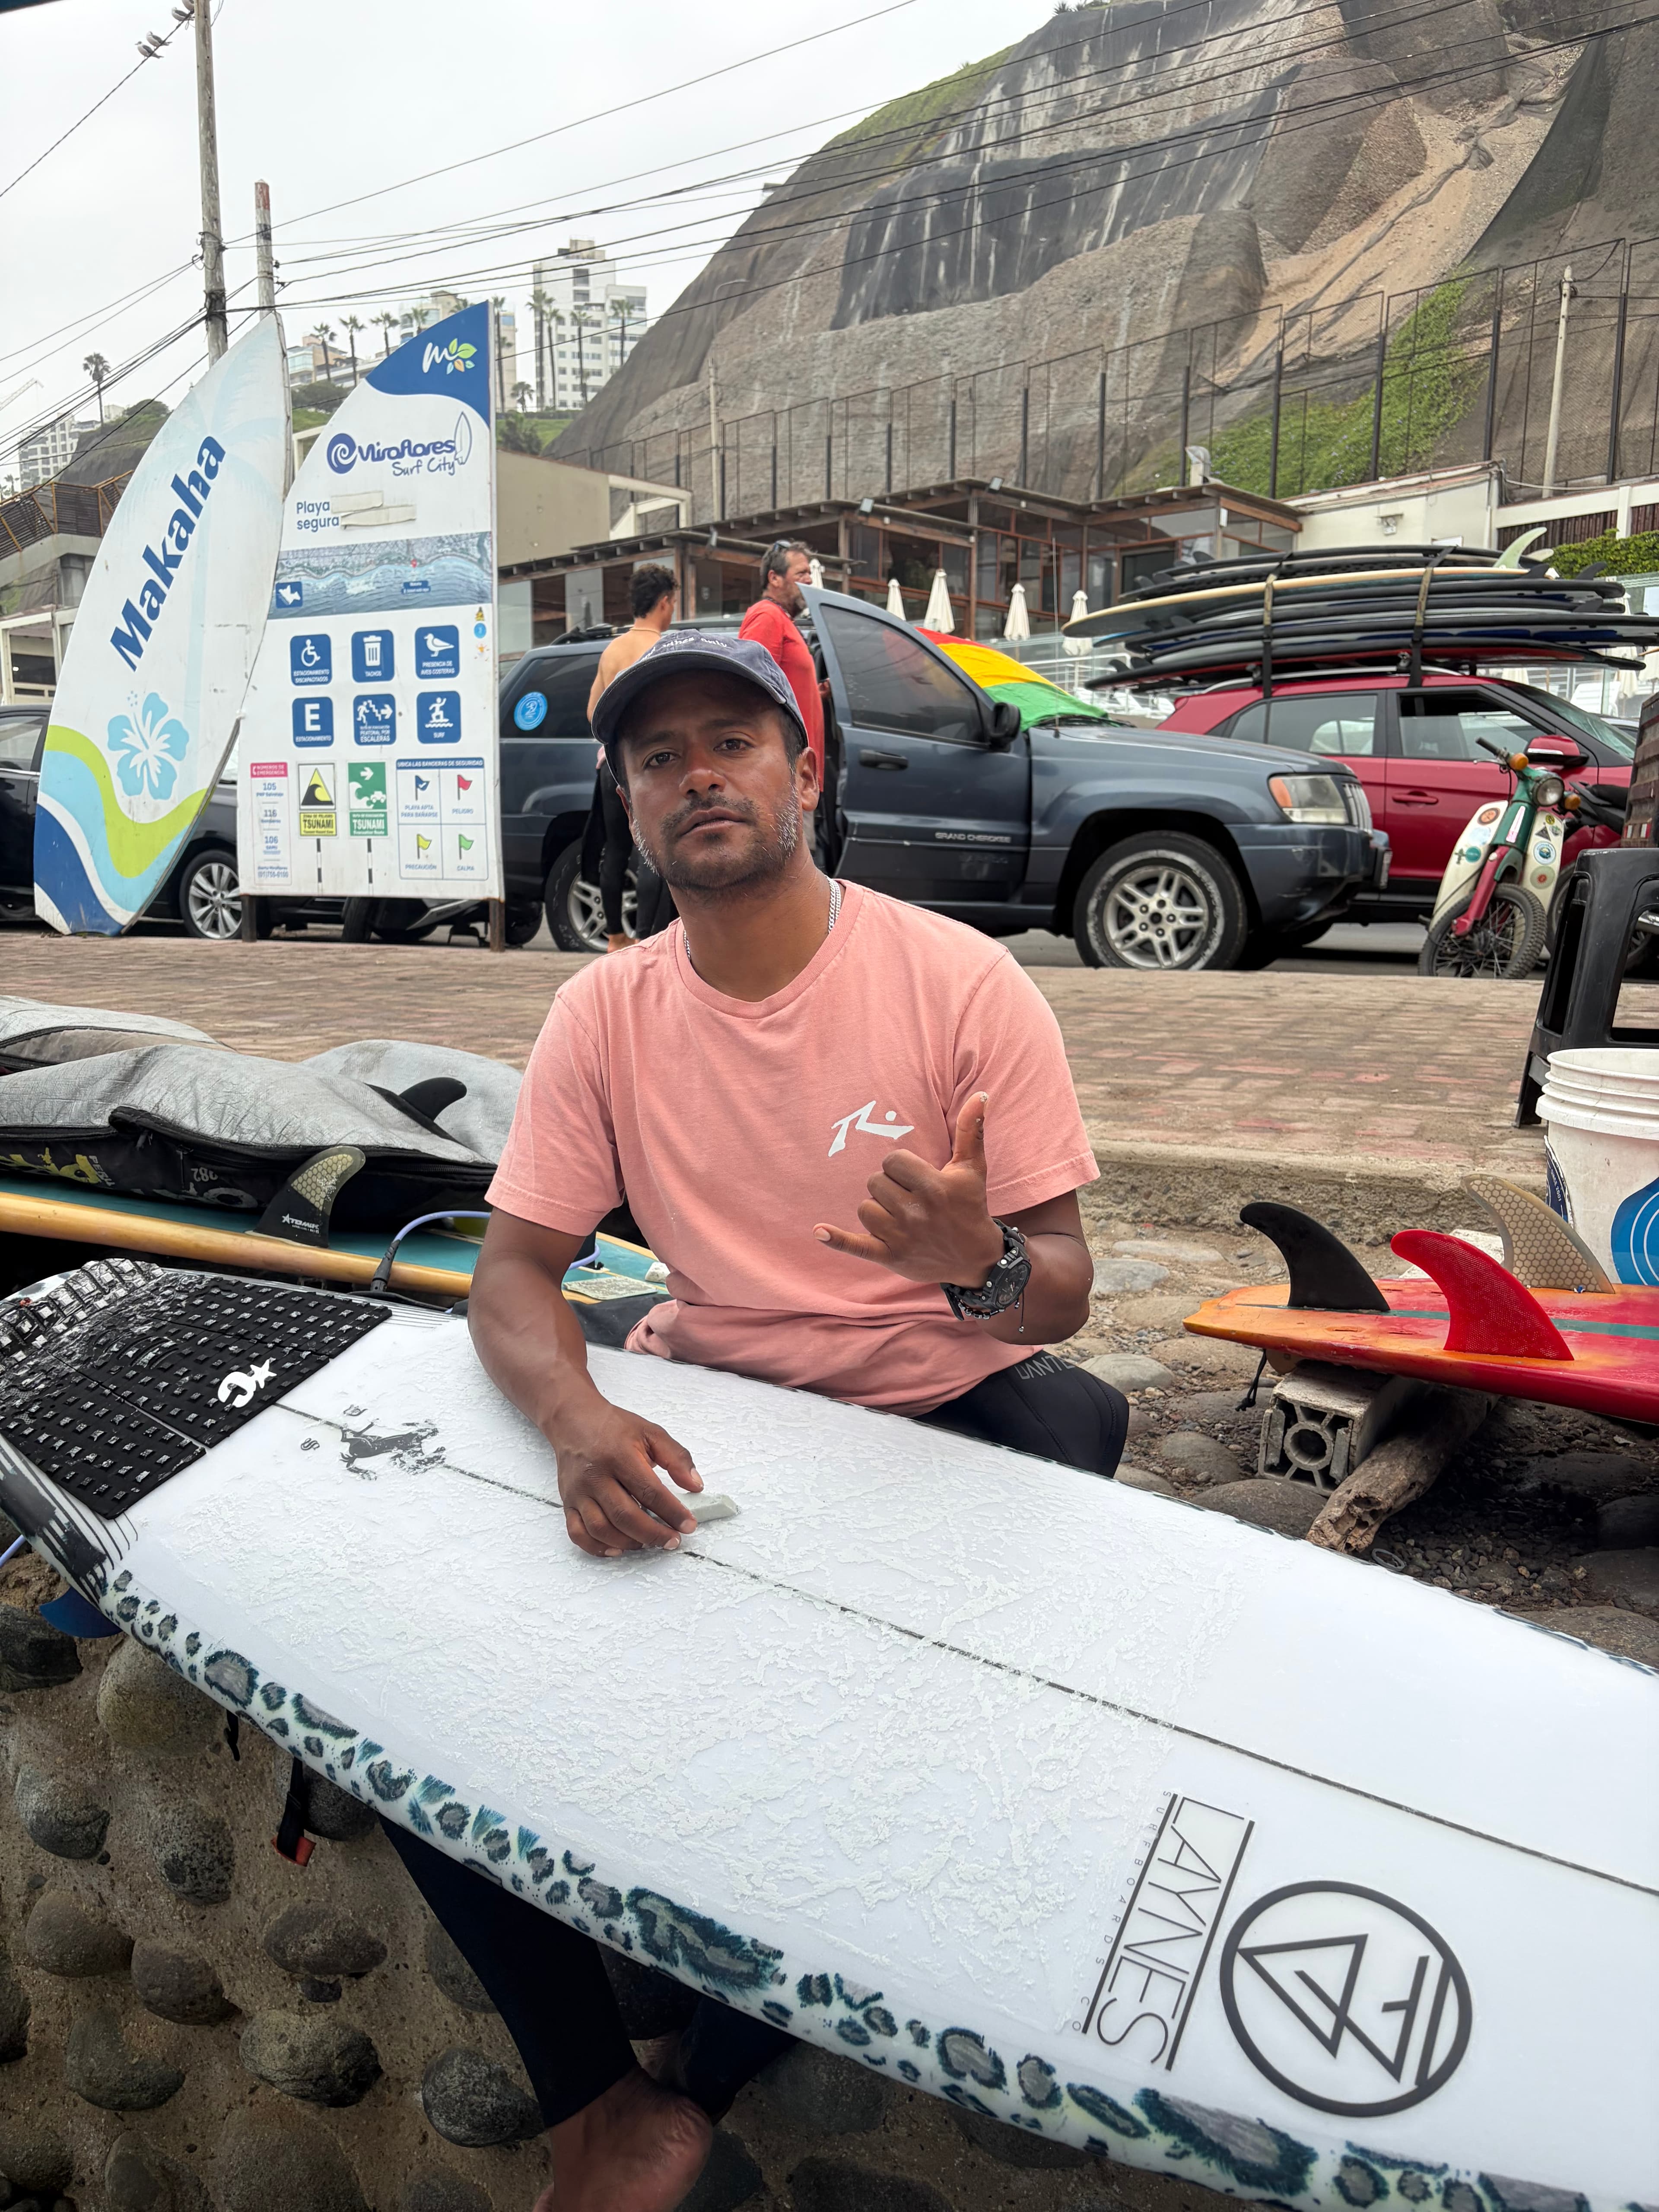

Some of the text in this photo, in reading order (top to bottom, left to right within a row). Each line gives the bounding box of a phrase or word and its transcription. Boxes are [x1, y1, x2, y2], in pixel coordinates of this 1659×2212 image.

[392, 458, 456, 477] Surf City
[297, 501, 330, 515] Playa
[297, 517, 339, 532] segura
[110, 436, 226, 672] Makaha
[305, 703, 321, 731] E
[263, 782, 276, 791] 105
[303, 820, 333, 829] TSUNAMI
[353, 820, 385, 830] TSUNAMI
[935, 832, 1011, 843] GRAND CHEROKEE
